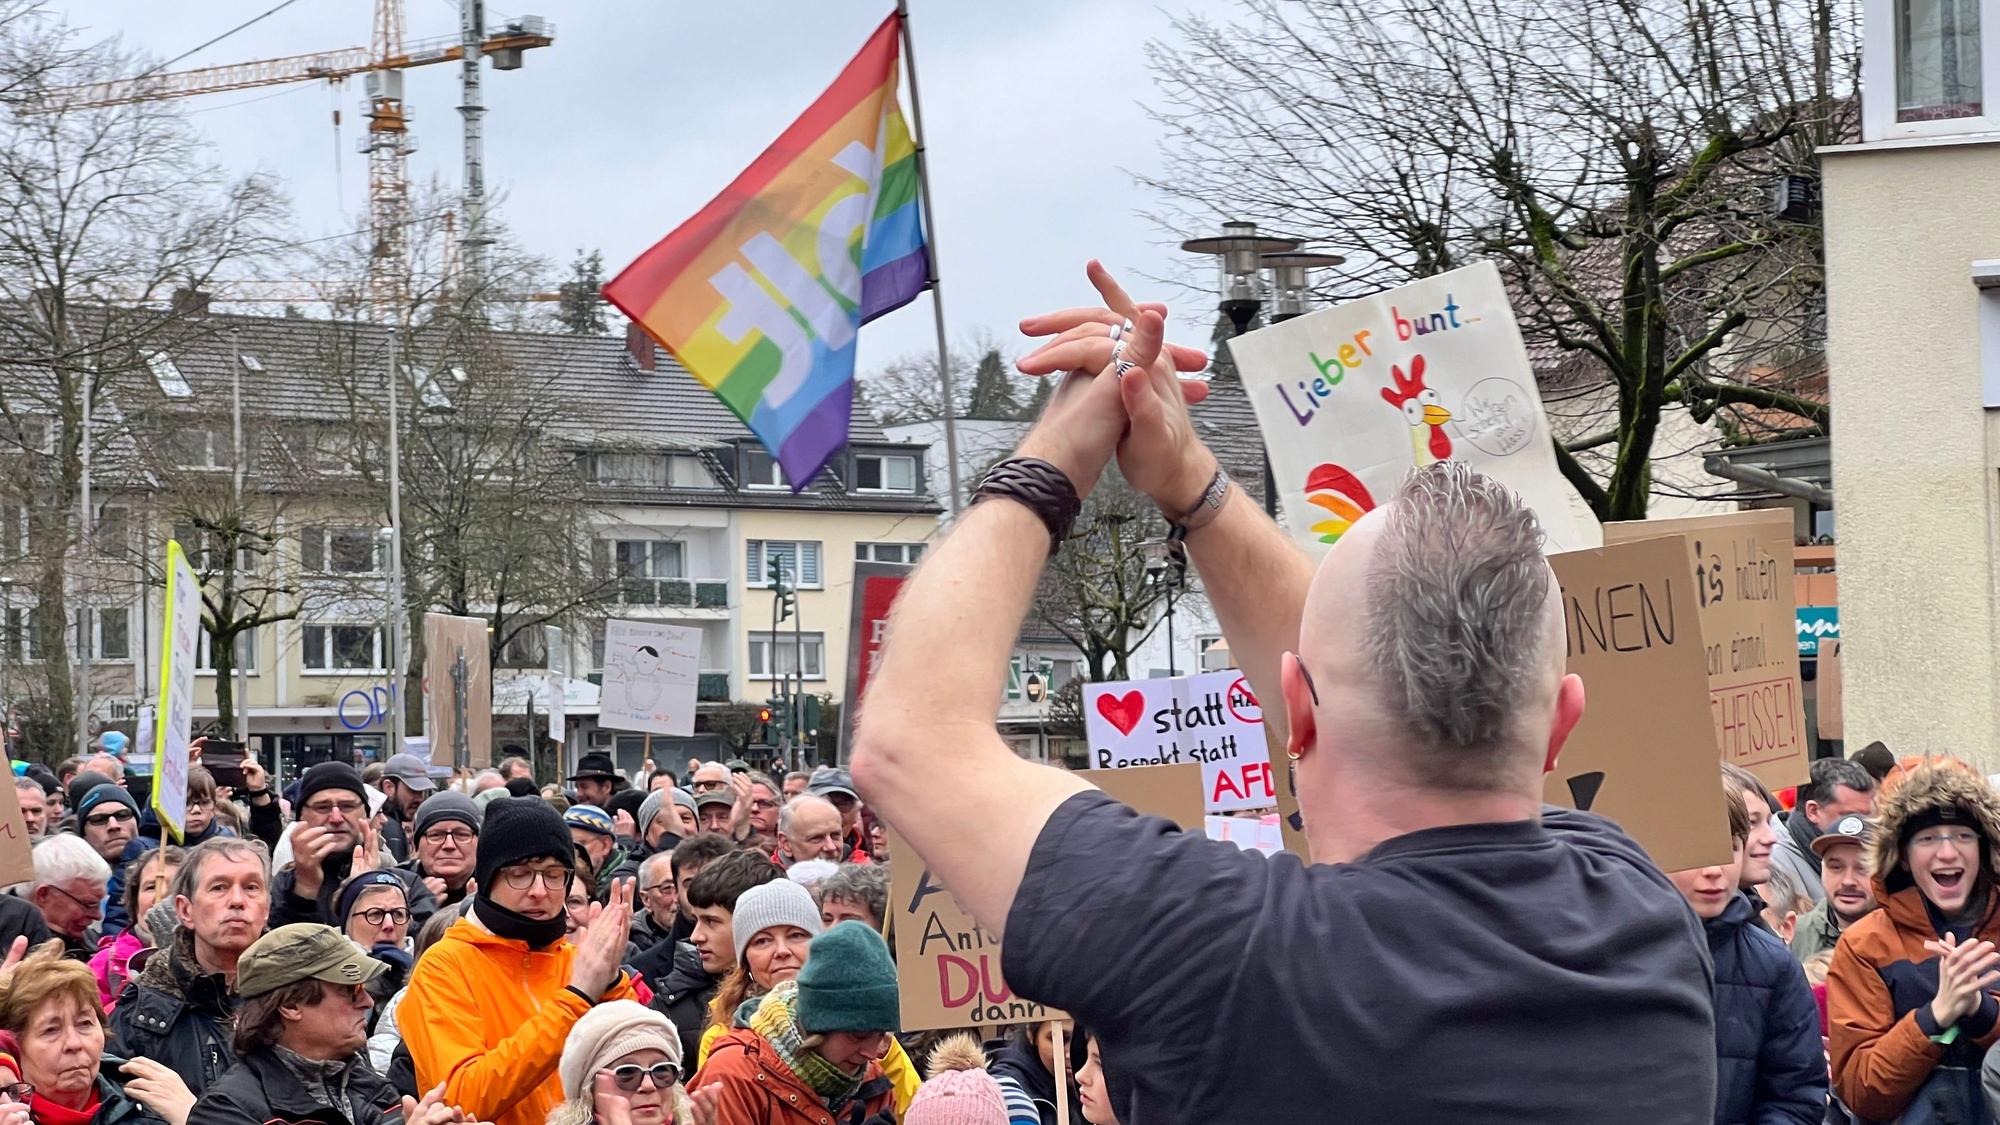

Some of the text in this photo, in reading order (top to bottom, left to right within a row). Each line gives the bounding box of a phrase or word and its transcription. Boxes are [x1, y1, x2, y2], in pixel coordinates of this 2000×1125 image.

[1276, 329, 1372, 427] Lieber
[1153, 692, 1226, 734] statt
[1711, 681, 1796, 761] HEISSE!
[1189, 735, 1238, 763] statt
[970, 992, 1045, 1022] dann
